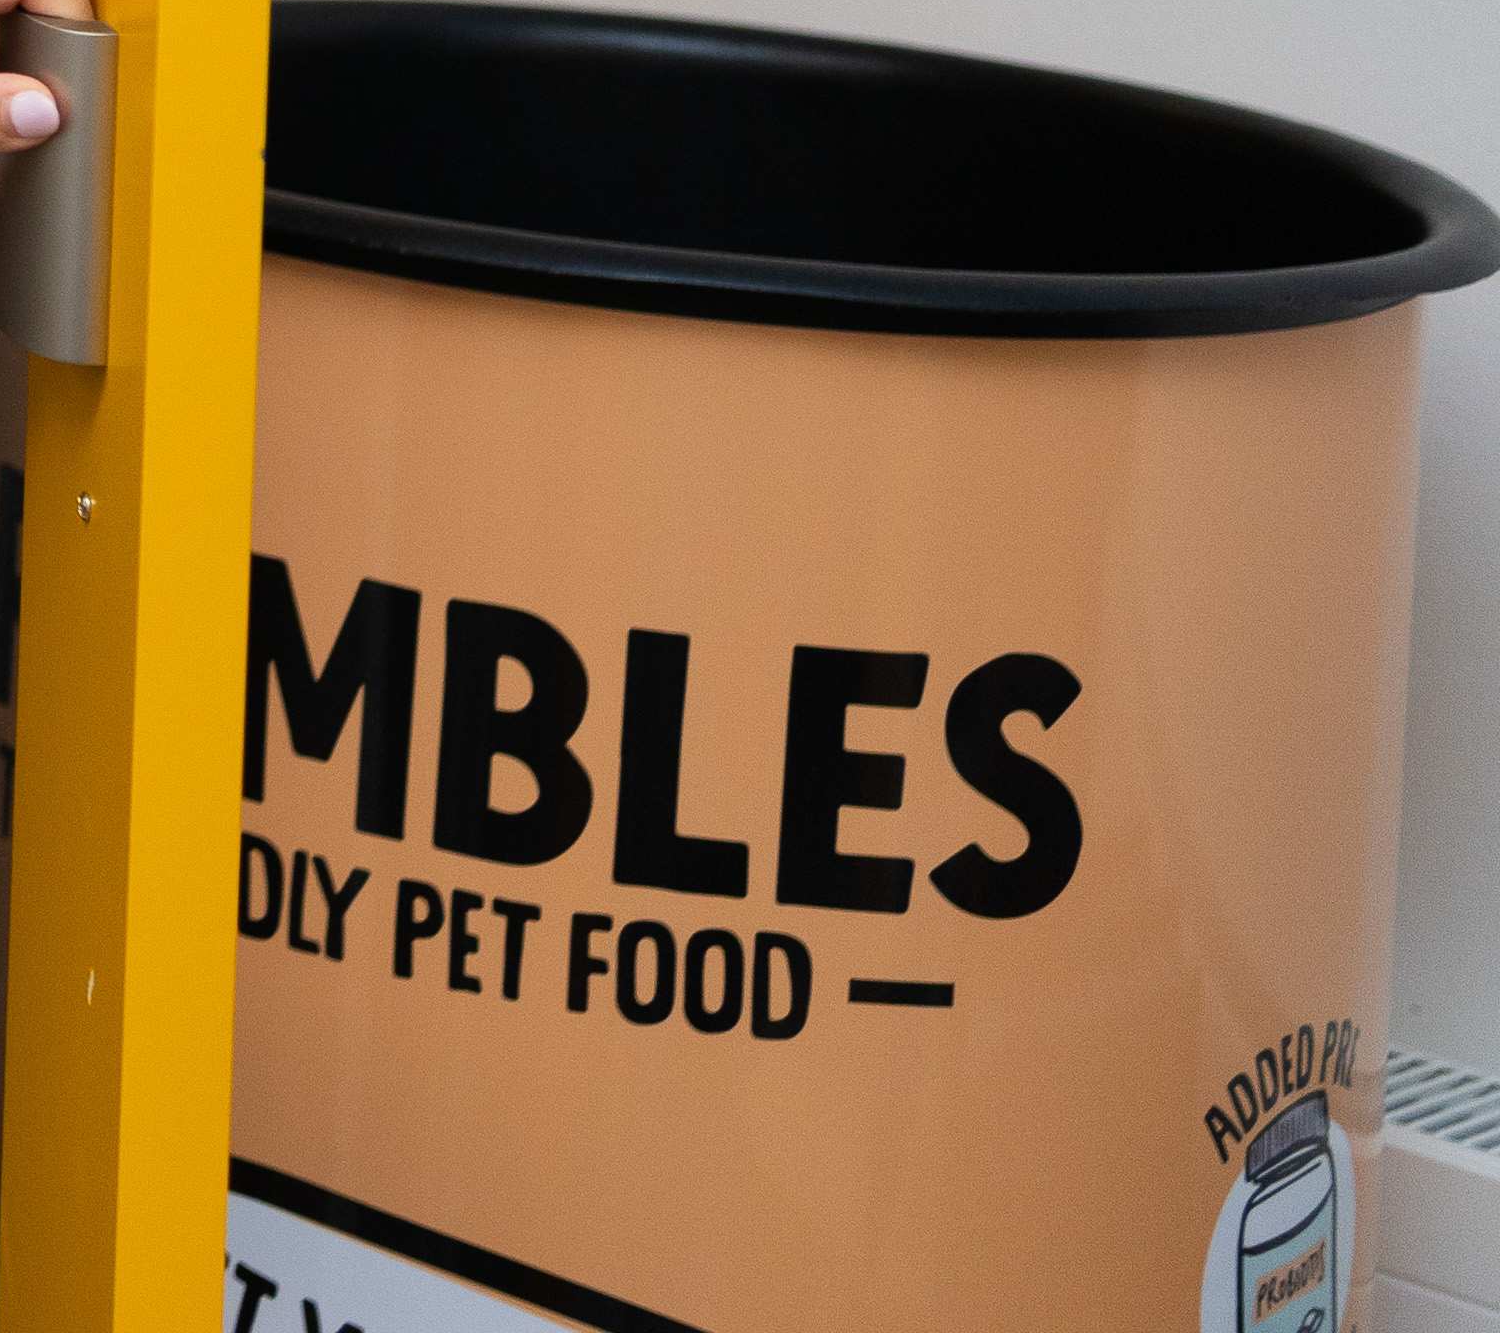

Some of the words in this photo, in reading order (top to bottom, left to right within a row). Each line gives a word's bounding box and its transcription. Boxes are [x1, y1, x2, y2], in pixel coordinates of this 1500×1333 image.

[393, 878, 542, 1000] PET
[566, 912, 813, 1040] FOOD
[1204, 1023, 1315, 1165] ADDED
